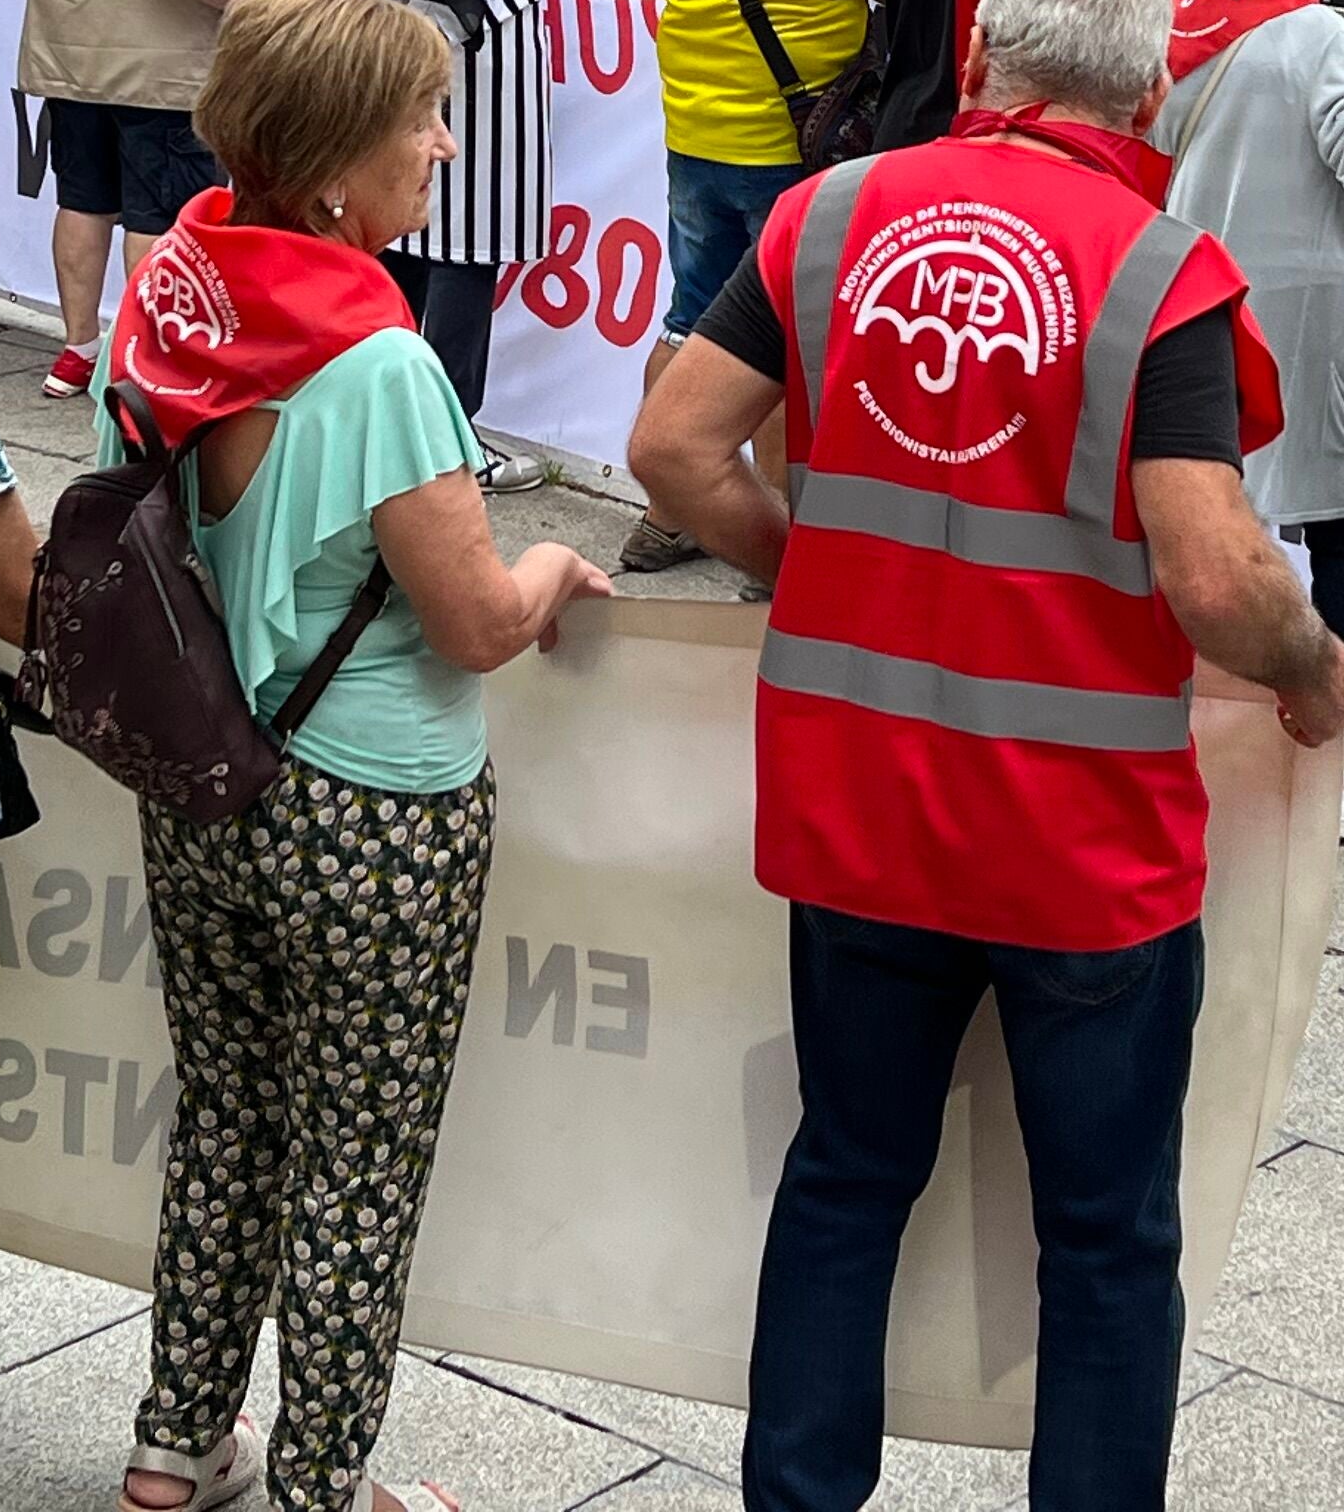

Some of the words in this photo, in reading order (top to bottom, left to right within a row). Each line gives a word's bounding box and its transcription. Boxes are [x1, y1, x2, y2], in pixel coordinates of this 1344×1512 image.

[910, 259, 1009, 328] MPB
[916, 205, 938, 223] DE
[942, 202, 1048, 252] PENSIONISTAS
[1041, 249, 1064, 273] DE
[1054, 273, 1077, 348] BIZKAIA
[1017, 248, 1060, 365] MUGIMENDUA
